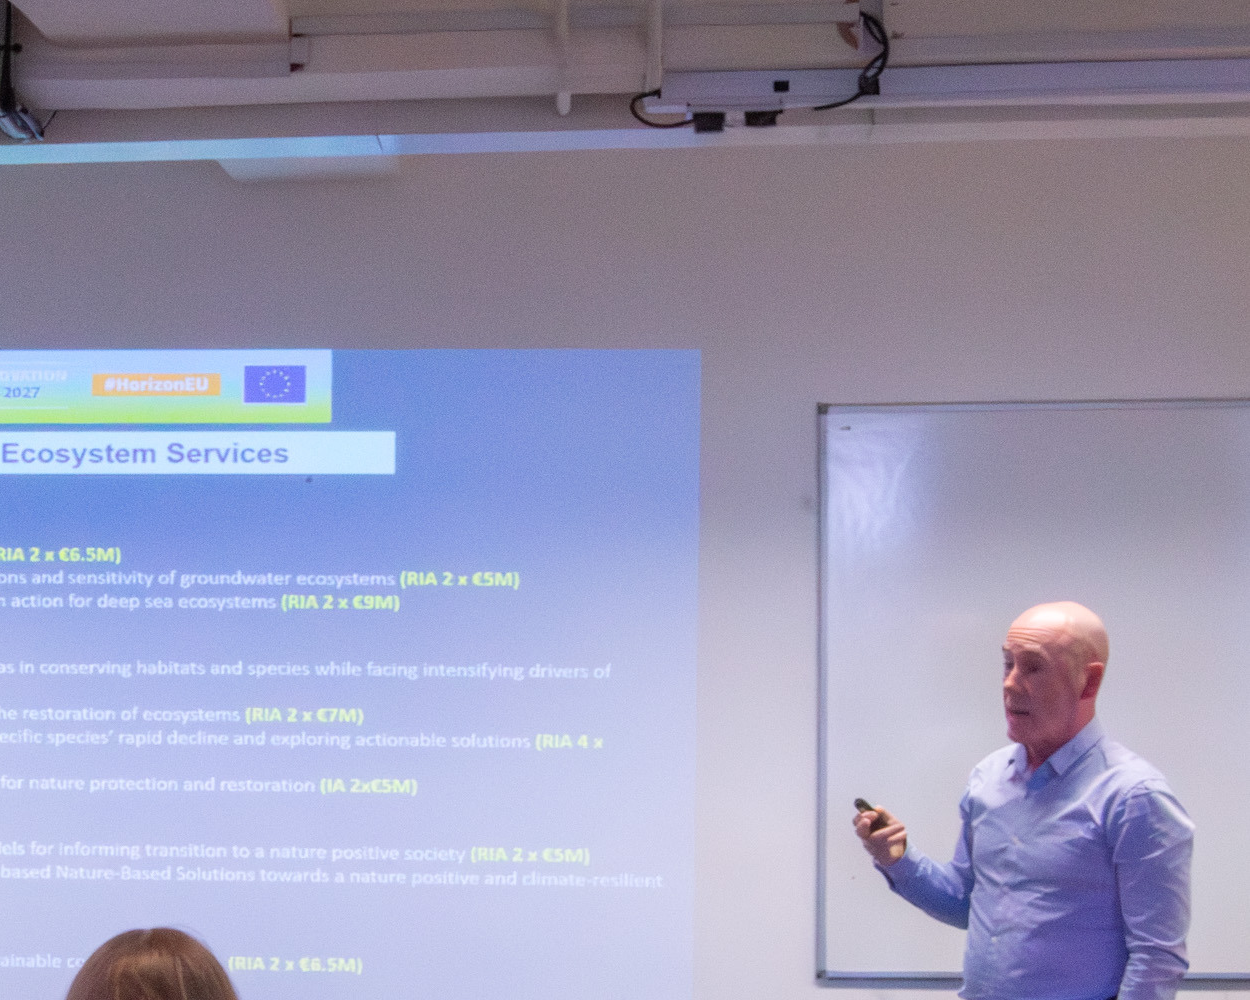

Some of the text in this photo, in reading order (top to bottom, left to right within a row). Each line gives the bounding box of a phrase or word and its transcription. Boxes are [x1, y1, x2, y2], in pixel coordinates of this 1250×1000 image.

[3, 386, 41, 399] 2027
[103, 376, 209, 392] #HorizonEU
[1, 443, 157, 469] Ecosystem
[166, 442, 289, 464] Services
[68, 570, 154, 588] sensitivity
[181, 570, 290, 588] groundwater
[296, 572, 394, 588] ecosystems
[400, 570, 438, 588] (RIA
[11, 593, 63, 608] action
[97, 594, 140, 611] deep
[144, 597, 173, 608] sea
[178, 595, 275, 611] ecosystems
[281, 593, 318, 611] (RIA
[39, 660, 132, 678] conserving
[136, 660, 206, 675] habitats
[247, 661, 310, 679] species
[314, 661, 362, 676] while
[366, 662, 418, 680] facing
[422, 662, 523, 680] intensifying
[529, 663, 588, 678] drivers
[22, 706, 116, 721] restoration
[142, 707, 239, 724] ecosystems
[245, 706, 282, 724] (RIA
[118, 730, 162, 747] rapid
[167, 730, 228, 745] decline
[270, 731, 350, 749] exploring
[356, 732, 445, 747] actionable
[451, 732, 529, 748] solutions
[535, 733, 573, 751] (RIA
[29, 776, 85, 790] nature
[90, 776, 178, 794] protection
[220, 777, 314, 792] restoration
[58, 841, 140, 860] informing
[145, 842, 227, 858] transition
[270, 845, 326, 859] nature
[332, 844, 398, 862] positive
[404, 845, 464, 863] society
[54, 864, 172, 881] Nature-Based
[175, 866, 255, 882] Solutions
[259, 867, 329, 883] towards
[349, 870, 406, 884] nature
[411, 869, 479, 887] positive
